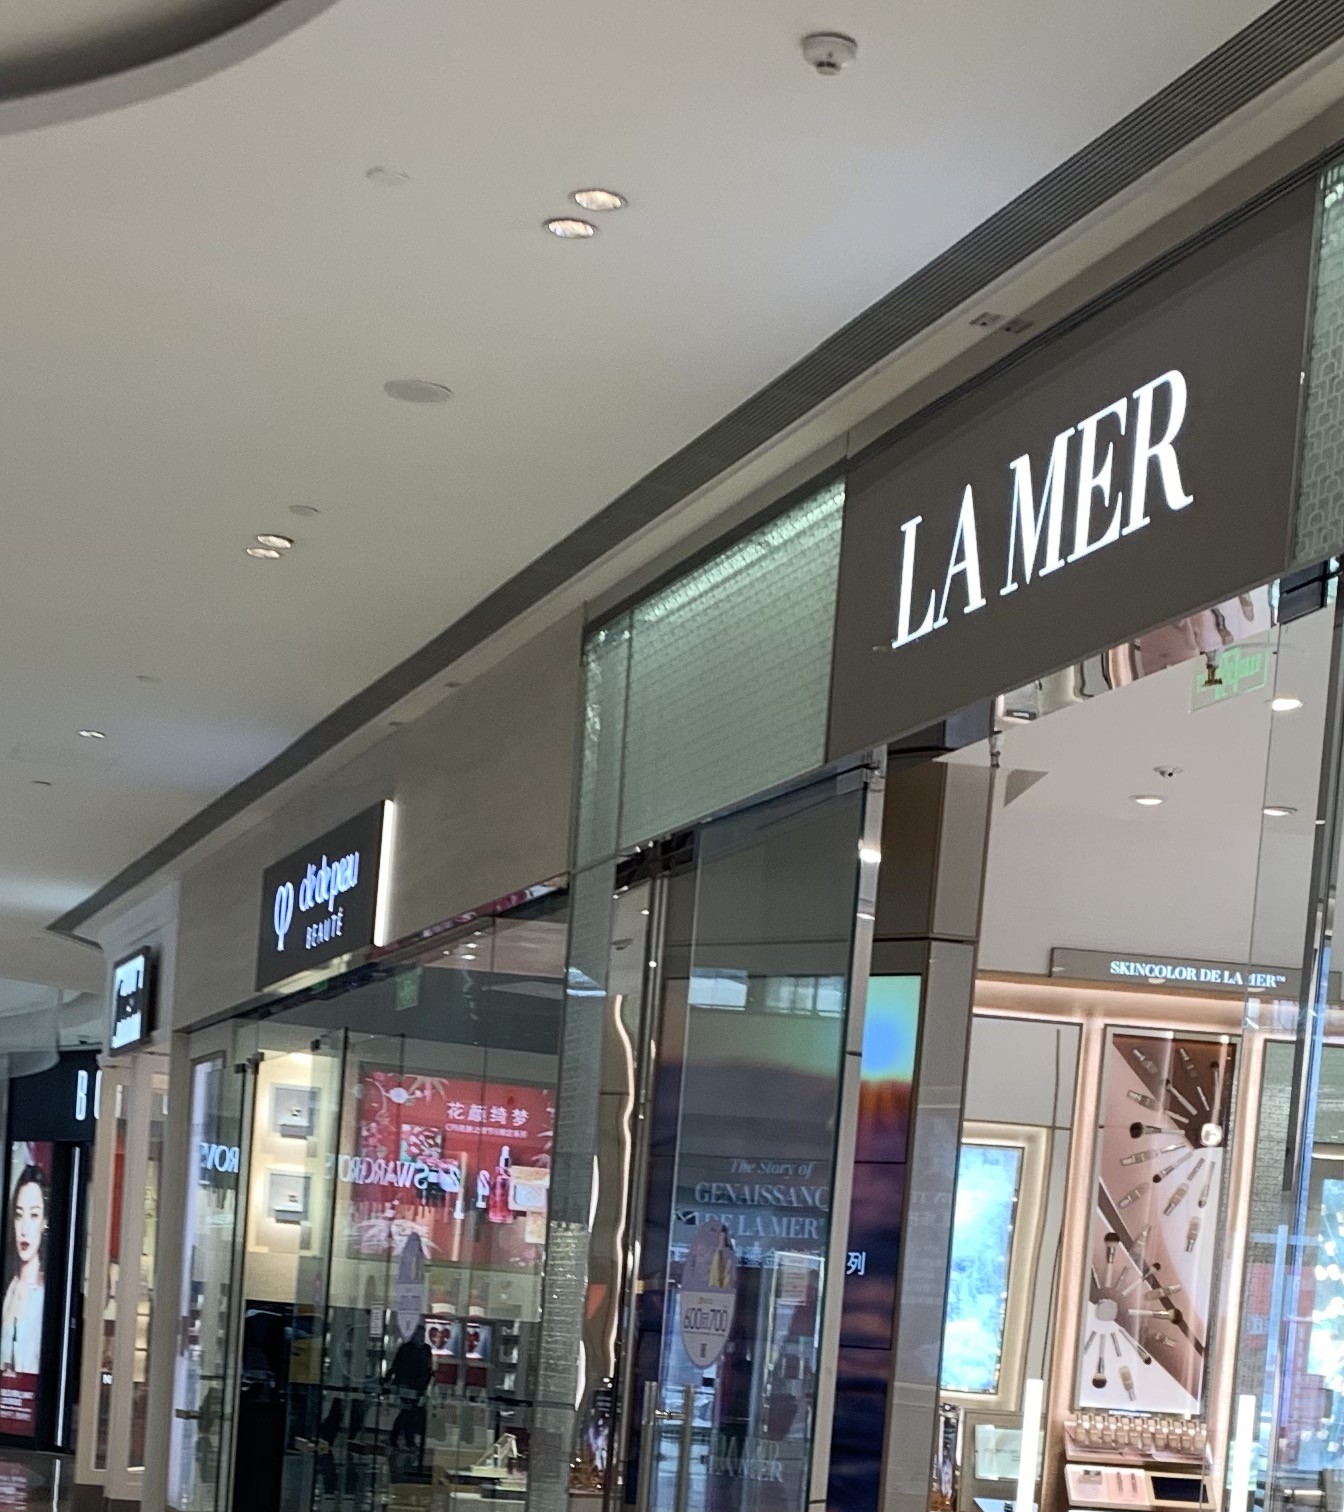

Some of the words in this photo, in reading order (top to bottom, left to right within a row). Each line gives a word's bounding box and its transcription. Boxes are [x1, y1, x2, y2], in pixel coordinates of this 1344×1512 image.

[892, 484, 987, 649] LA
[1000, 370, 1194, 595] MER
[1110, 960, 1197, 981] SKINCOLOR
[1200, 968, 1221, 983] DE
[1222, 971, 1243, 985] LA
